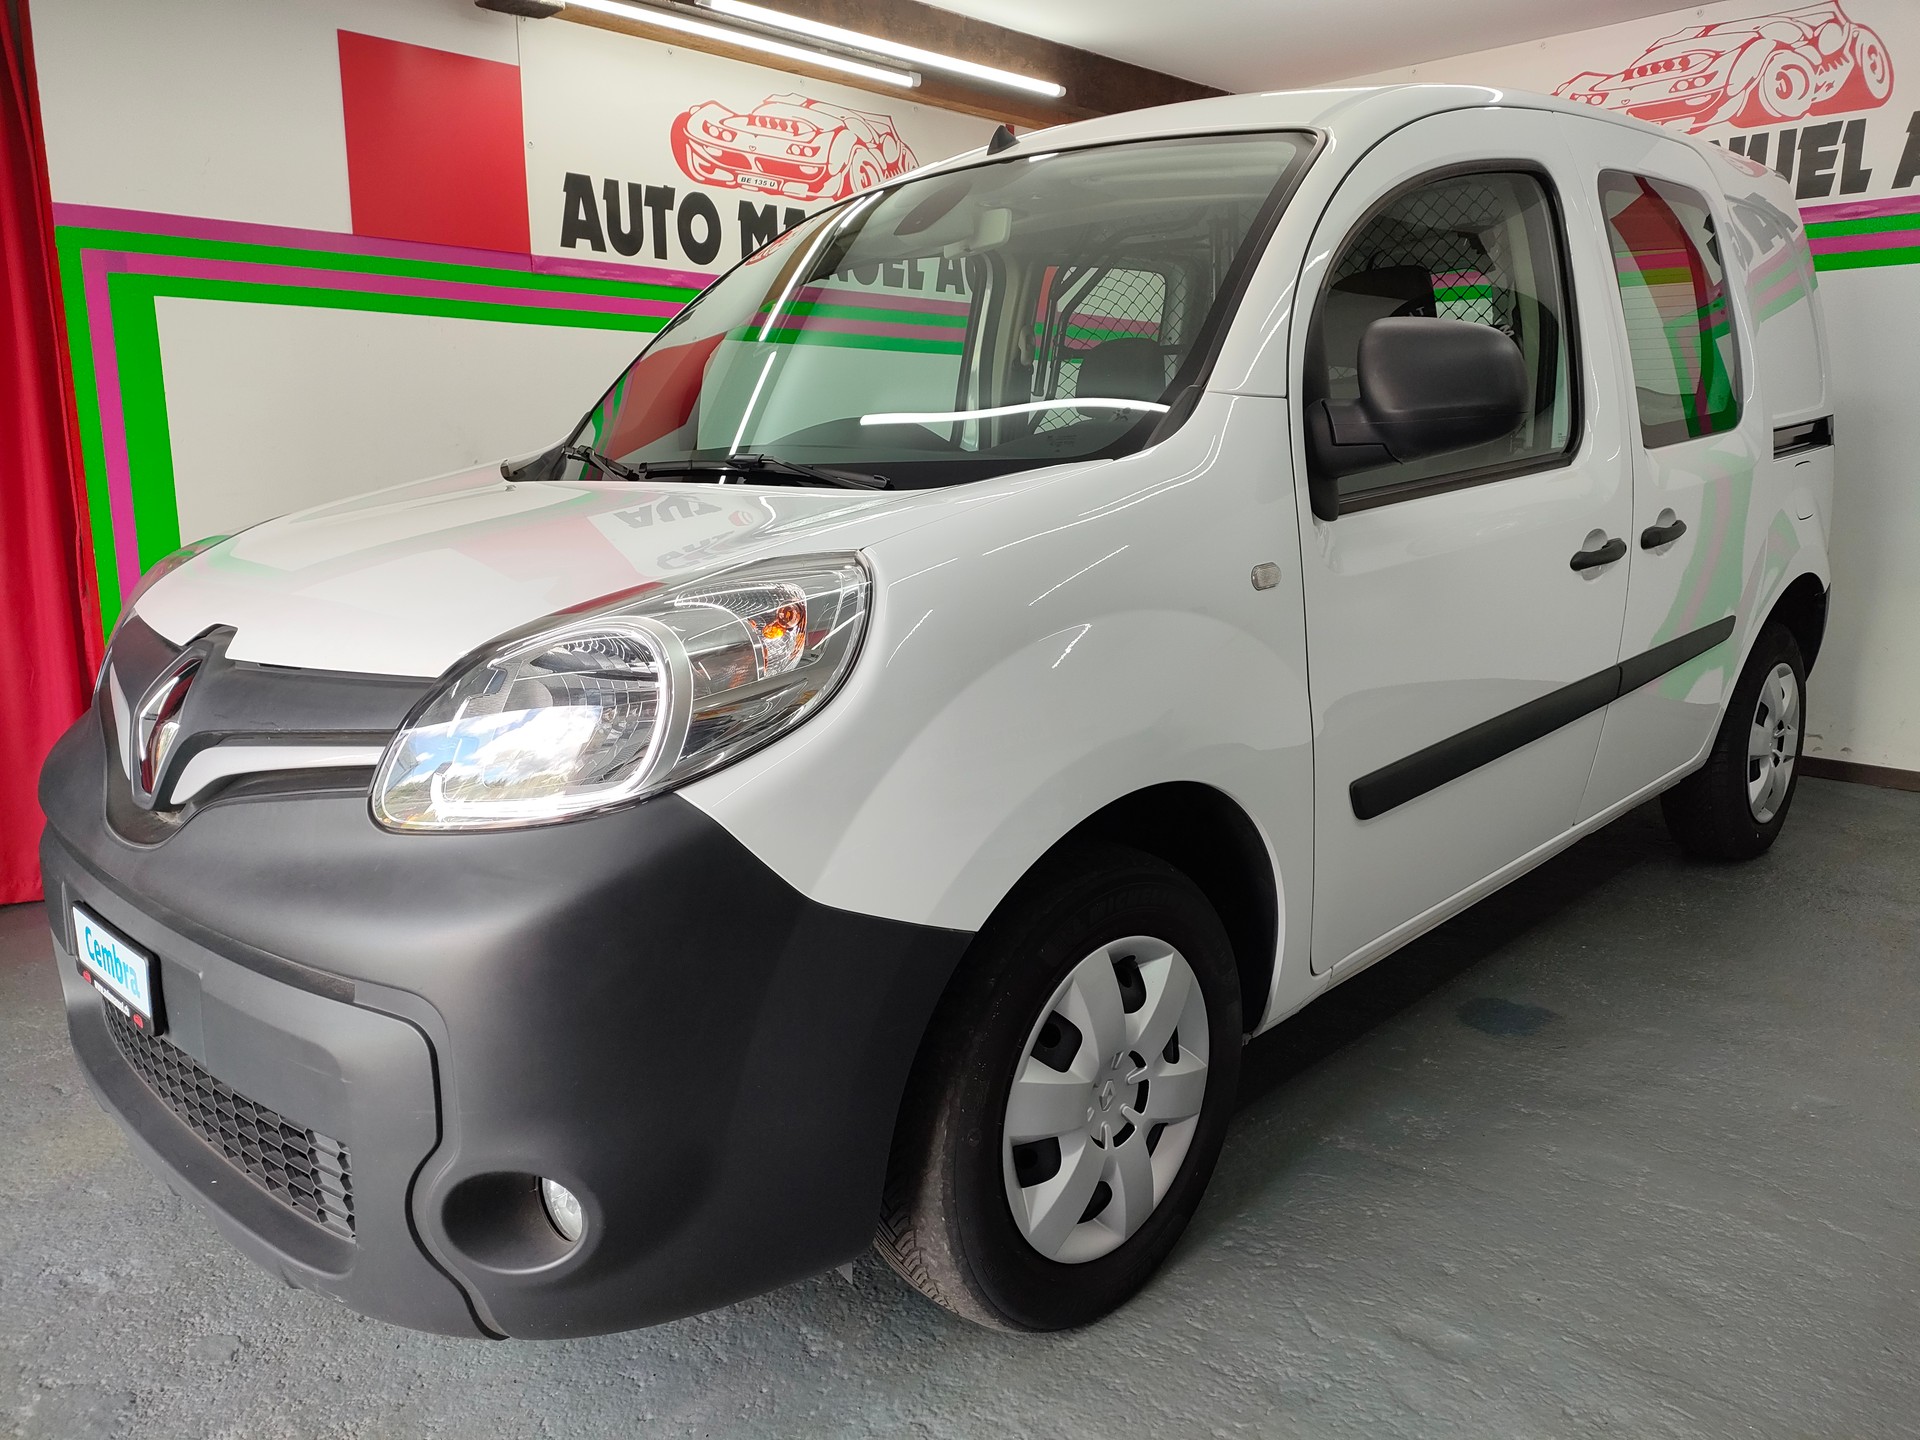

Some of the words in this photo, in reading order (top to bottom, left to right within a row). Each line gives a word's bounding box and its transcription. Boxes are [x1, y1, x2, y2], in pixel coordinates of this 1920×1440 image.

[560, 171, 722, 266] AUTO
[740, 176, 753, 185] BE
[754, 179, 768, 187] 135
[85, 925, 141, 999] Cembra
